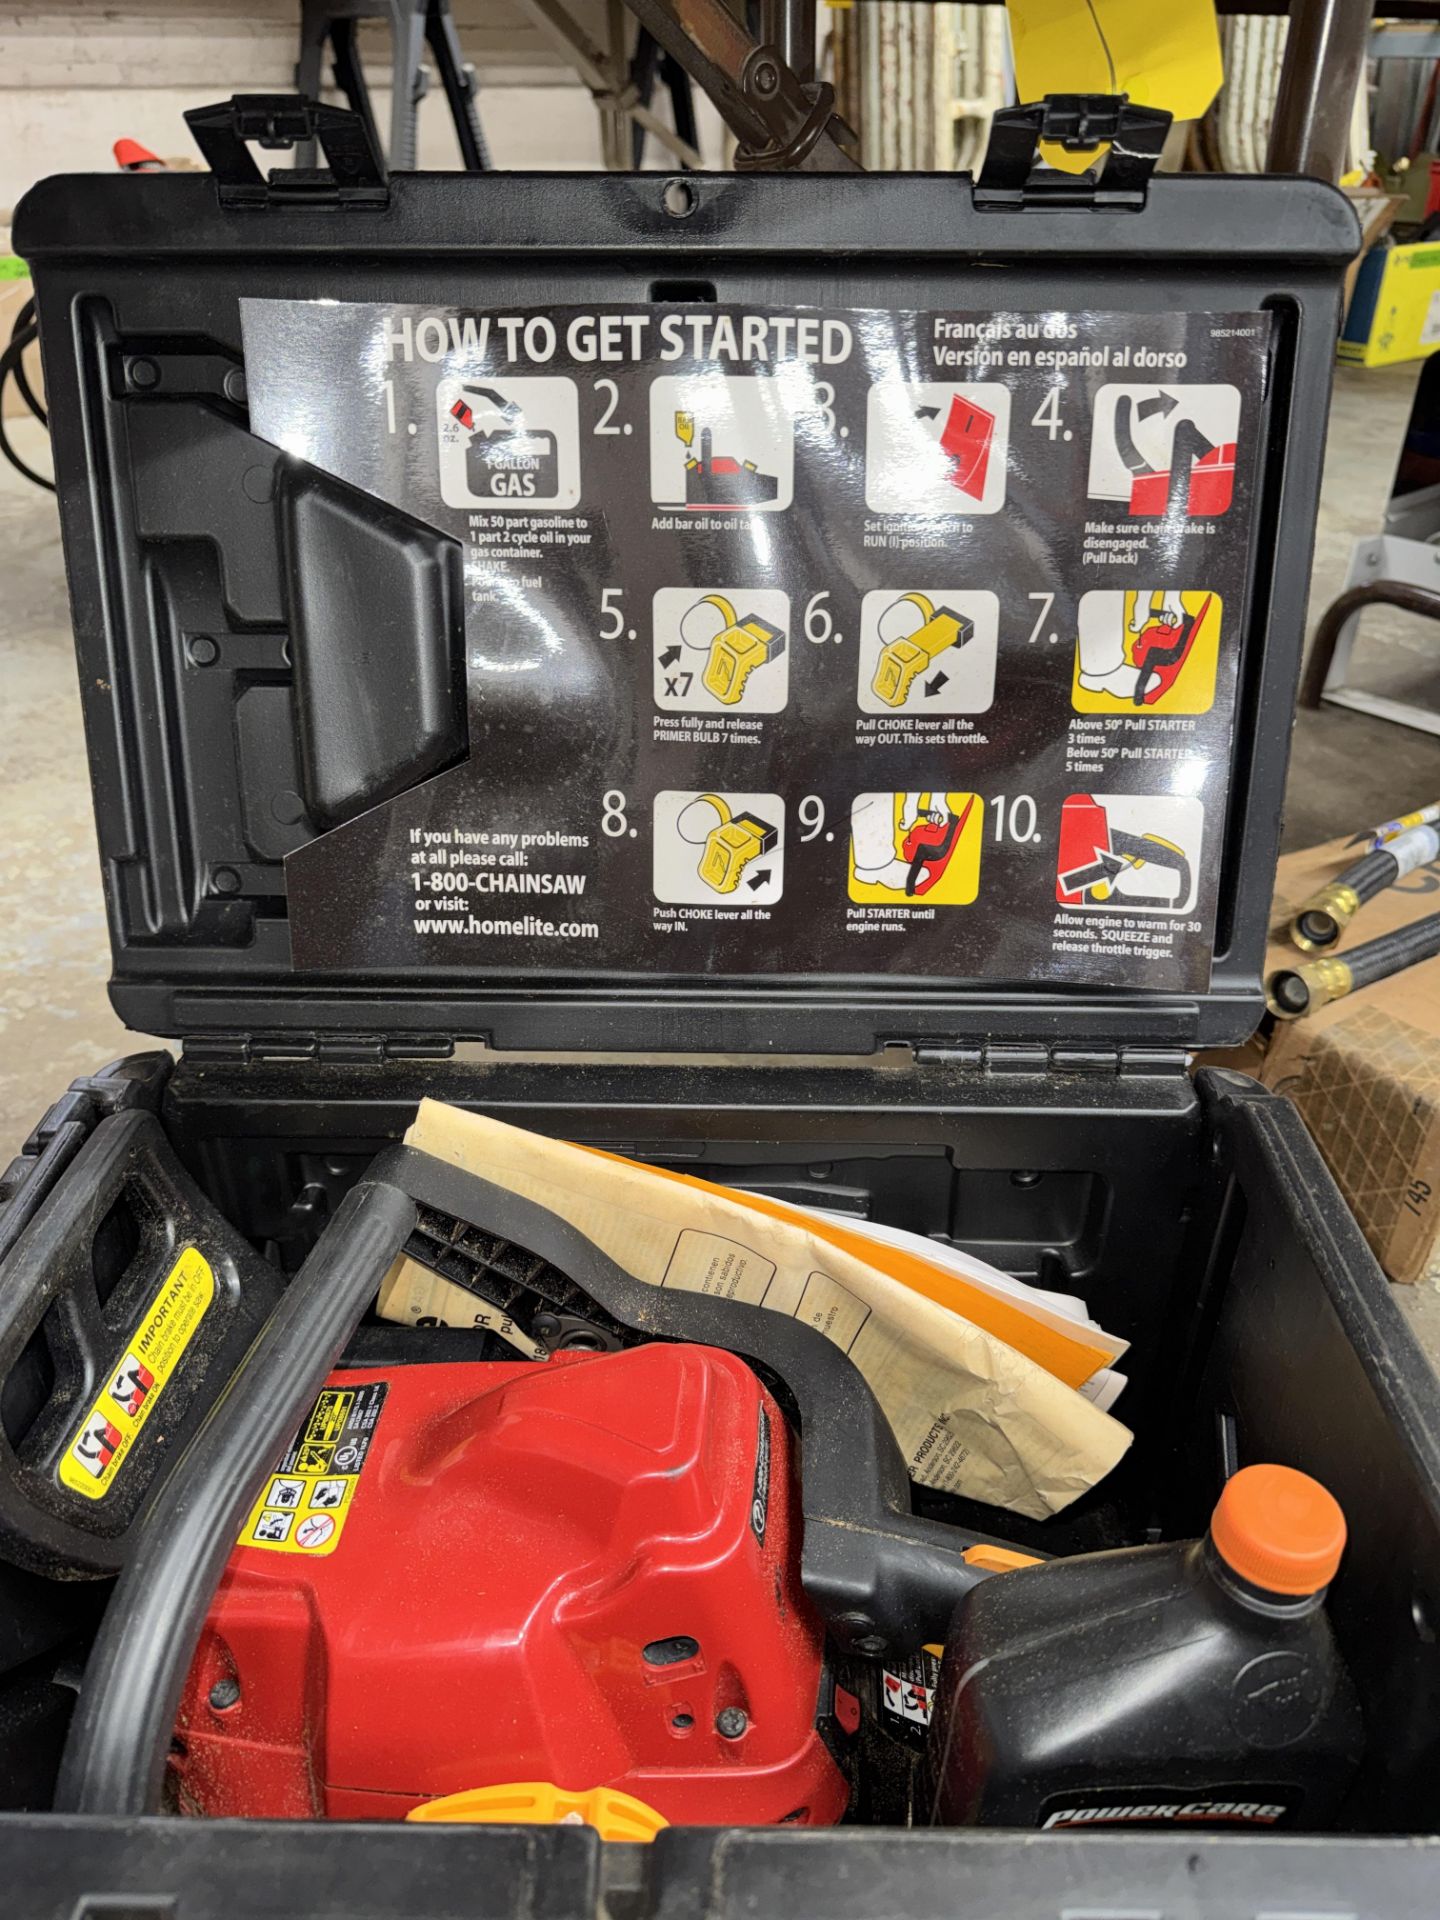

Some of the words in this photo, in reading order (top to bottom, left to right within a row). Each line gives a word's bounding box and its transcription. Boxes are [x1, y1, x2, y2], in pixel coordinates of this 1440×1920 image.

[934, 318, 1012, 343] Français
[1015, 323, 1039, 339] au
[1210, 328, 1256, 338] 985214001
[384, 315, 490, 363] HOW
[498, 316, 558, 362] TO
[567, 315, 650, 362] GET
[660, 315, 854, 364] STARTED
[933, 345, 1004, 367] Versión
[1007, 351, 1032, 367] en
[1035, 345, 1110, 371] español
[1112, 345, 1131, 367] al
[1133, 345, 1188, 368] dorso
[593, 378, 634, 437] 2.
[1031, 386, 1074, 442] 4.
[442, 423, 460, 433] 2.6
[442, 434, 460, 443] oz.
[494, 457, 540, 471] GALLON
[490, 472, 536, 498] GAS
[469, 515, 489, 528] Mix
[490, 516, 505, 528] 50
[506, 516, 529, 530] part
[530, 516, 575, 531] gasoline
[576, 518, 588, 529] to
[651, 517, 672, 530] Add
[675, 517, 693, 530] bar
[695, 517, 709, 530] oil
[710, 519, 722, 530] to
[724, 517, 737, 530] oil
[863, 519, 881, 532] Set
[962, 522, 974, 533] to
[1085, 521, 1115, 534] Make
[1116, 524, 1140, 534] sure
[1206, 522, 1216, 535] is
[470, 531, 476, 542] 1
[478, 531, 502, 545] part
[503, 531, 511, 543] 2
[511, 531, 538, 546] cycle
[540, 531, 553, 544] oil
[555, 531, 566, 544] in
[567, 533, 591, 546] your
[863, 535, 887, 548] RUN
[1083, 536, 1150, 552] disengaged.
[470, 548, 490, 560] gas
[491, 546, 544, 559] container.
[1082, 551, 1108, 566] (Pull
[1108, 551, 1138, 566] back)
[522, 575, 542, 588] fuel
[599, 588, 637, 641] 5.
[804, 591, 843, 645] 6.
[1028, 592, 1058, 644] 7.
[664, 671, 694, 697] x7
[653, 715, 680, 728] Press
[681, 716, 704, 731] fully
[705, 718, 725, 730] and
[726, 718, 764, 730] release
[856, 718, 876, 731] Pull
[877, 719, 914, 731] CHOKE
[915, 718, 941, 731] lever
[942, 718, 956, 731] all
[957, 718, 975, 731] the
[1069, 718, 1103, 731] Above
[1125, 719, 1146, 731] Pull
[1147, 719, 1196, 731] STARTER
[653, 729, 692, 742] PRIMER
[693, 731, 720, 743] BULB
[721, 732, 729, 744] 7
[730, 732, 761, 745] times.
[855, 734, 877, 747] way
[877, 733, 902, 744] OUT.
[902, 733, 924, 744] This
[924, 734, 946, 745] sets
[947, 732, 990, 744] throttle.
[1067, 733, 1075, 744] 3
[1076, 732, 1106, 745] times
[1066, 746, 1100, 759] Below
[1121, 747, 1142, 759] Pull
[1065, 761, 1073, 772] 5
[1074, 761, 1104, 773] times
[601, 789, 638, 839] 8.
[799, 794, 835, 843] 9.
[990, 794, 1042, 844] 10.
[410, 828, 422, 844] If
[423, 832, 451, 848] you
[454, 828, 490, 845] have
[491, 833, 519, 849] any
[521, 831, 590, 848] problems
[410, 850, 427, 865] at
[428, 849, 447, 865] all
[450, 849, 497, 867] please
[498, 850, 529, 867] call:
[411, 872, 587, 895] 1-800-CHAINSAW
[415, 898, 432, 911] or
[434, 895, 470, 912] visit:
[653, 907, 677, 919] Push
[678, 908, 714, 920] CHOKE
[714, 909, 739, 920] lever
[740, 909, 753, 920] all
[754, 909, 772, 920] the
[846, 908, 867, 919] Pull
[867, 908, 910, 920] STARTER
[911, 908, 935, 920] until
[413, 914, 600, 938] www.homelite.com
[653, 922, 673, 934] way
[674, 921, 688, 932] IN.
[846, 921, 880, 934] engine
[881, 922, 906, 932] runs.
[1054, 913, 1084, 926] Allow
[1085, 916, 1122, 930] engine
[1123, 917, 1136, 929] to
[1137, 920, 1168, 930] warm
[1169, 919, 1186, 932] for
[1187, 921, 1202, 933] 30
[1053, 928, 1098, 941] seconds.
[1101, 929, 1151, 944] SQUEEZE
[1151, 933, 1174, 945] and
[1052, 941, 1090, 953] release
[1091, 942, 1132, 956] throttle
[1133, 945, 1174, 960] trigger.
[718, 1252, 736, 1280] sabidos
[701, 1256, 720, 1293] contienen
[714, 1281, 724, 1295] son
[137, 1271, 188, 1353] IMPORTANT
[811, 1310, 823, 1323] de
[147, 1339, 164, 1363] Chain
[173, 1301, 186, 1319] must
[156, 1341, 175, 1372] position
[171, 1333, 181, 1343] to
